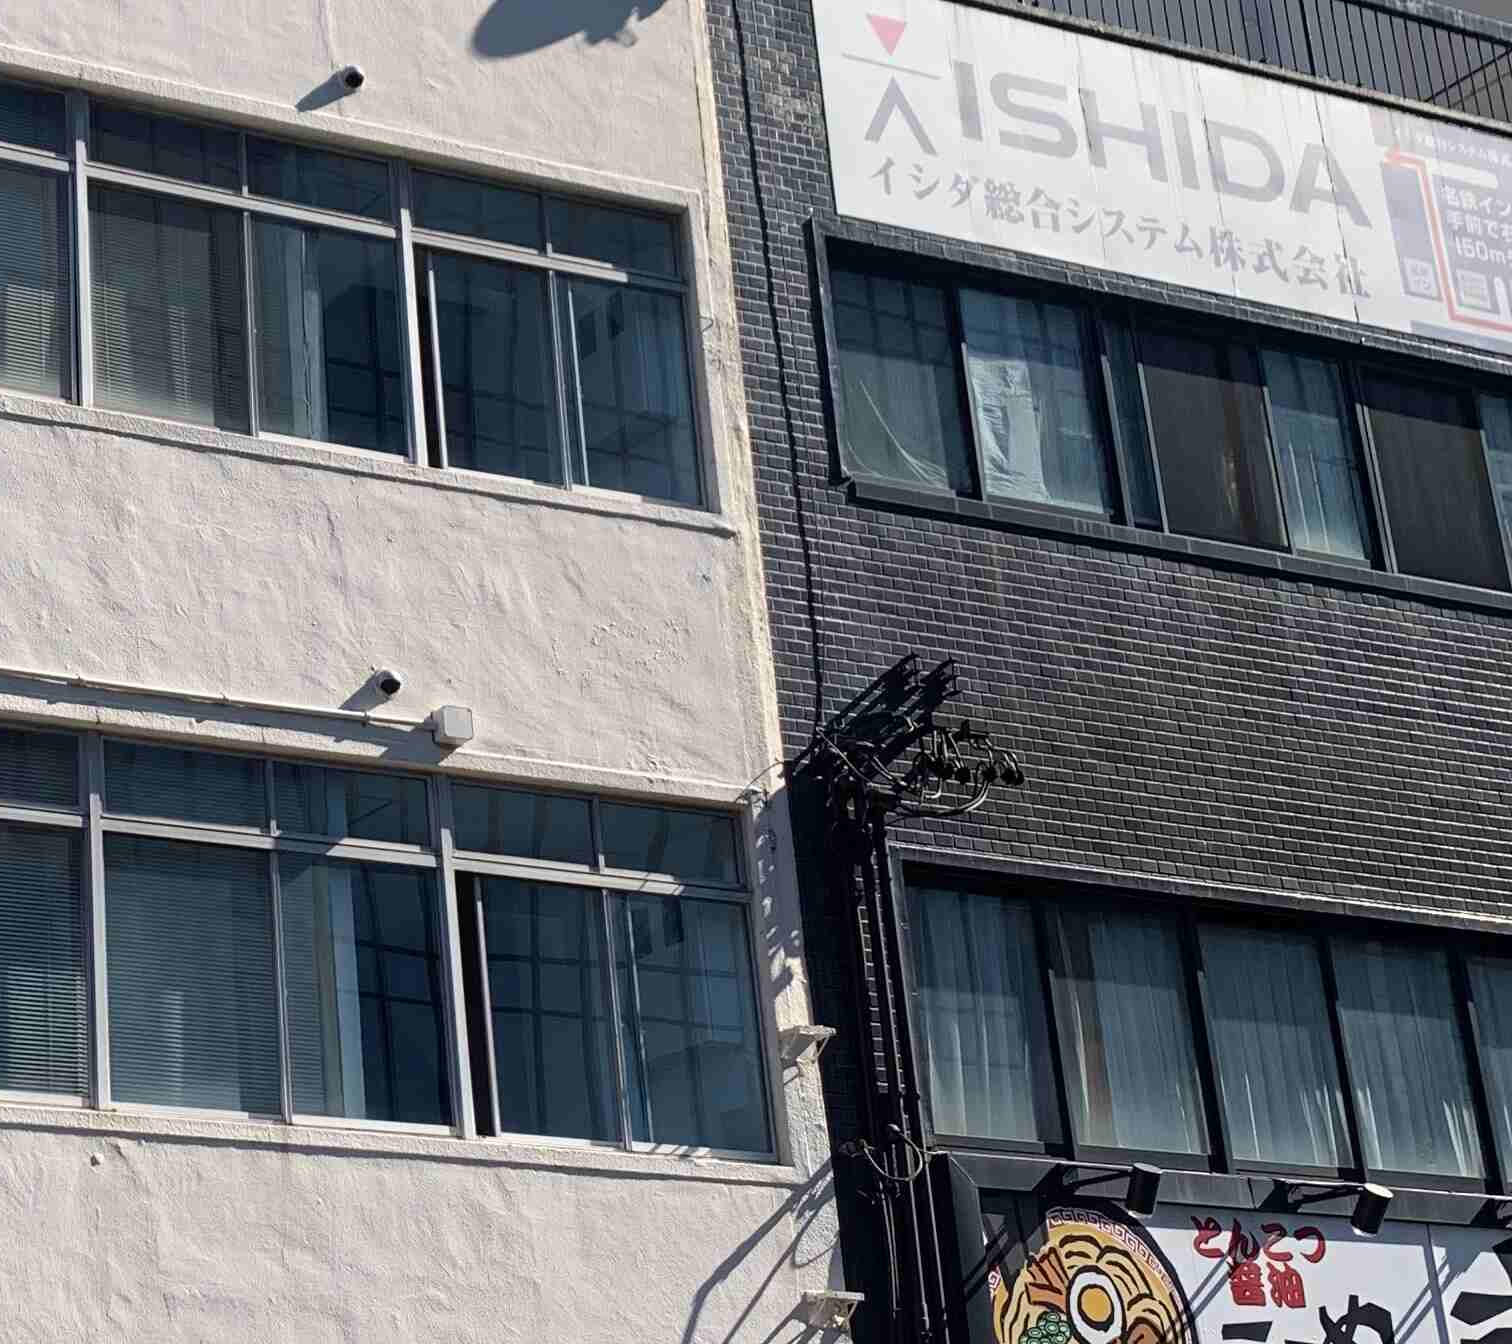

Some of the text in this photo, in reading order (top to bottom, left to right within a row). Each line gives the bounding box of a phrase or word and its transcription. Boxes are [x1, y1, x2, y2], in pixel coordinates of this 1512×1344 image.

[953, 60, 1372, 229] ISHIDA
[869, 157, 1372, 300] イシダ総合システム株式会社
[1191, 1215, 1327, 1264] とんこつ
[1228, 1260, 1306, 1309] 醤油
